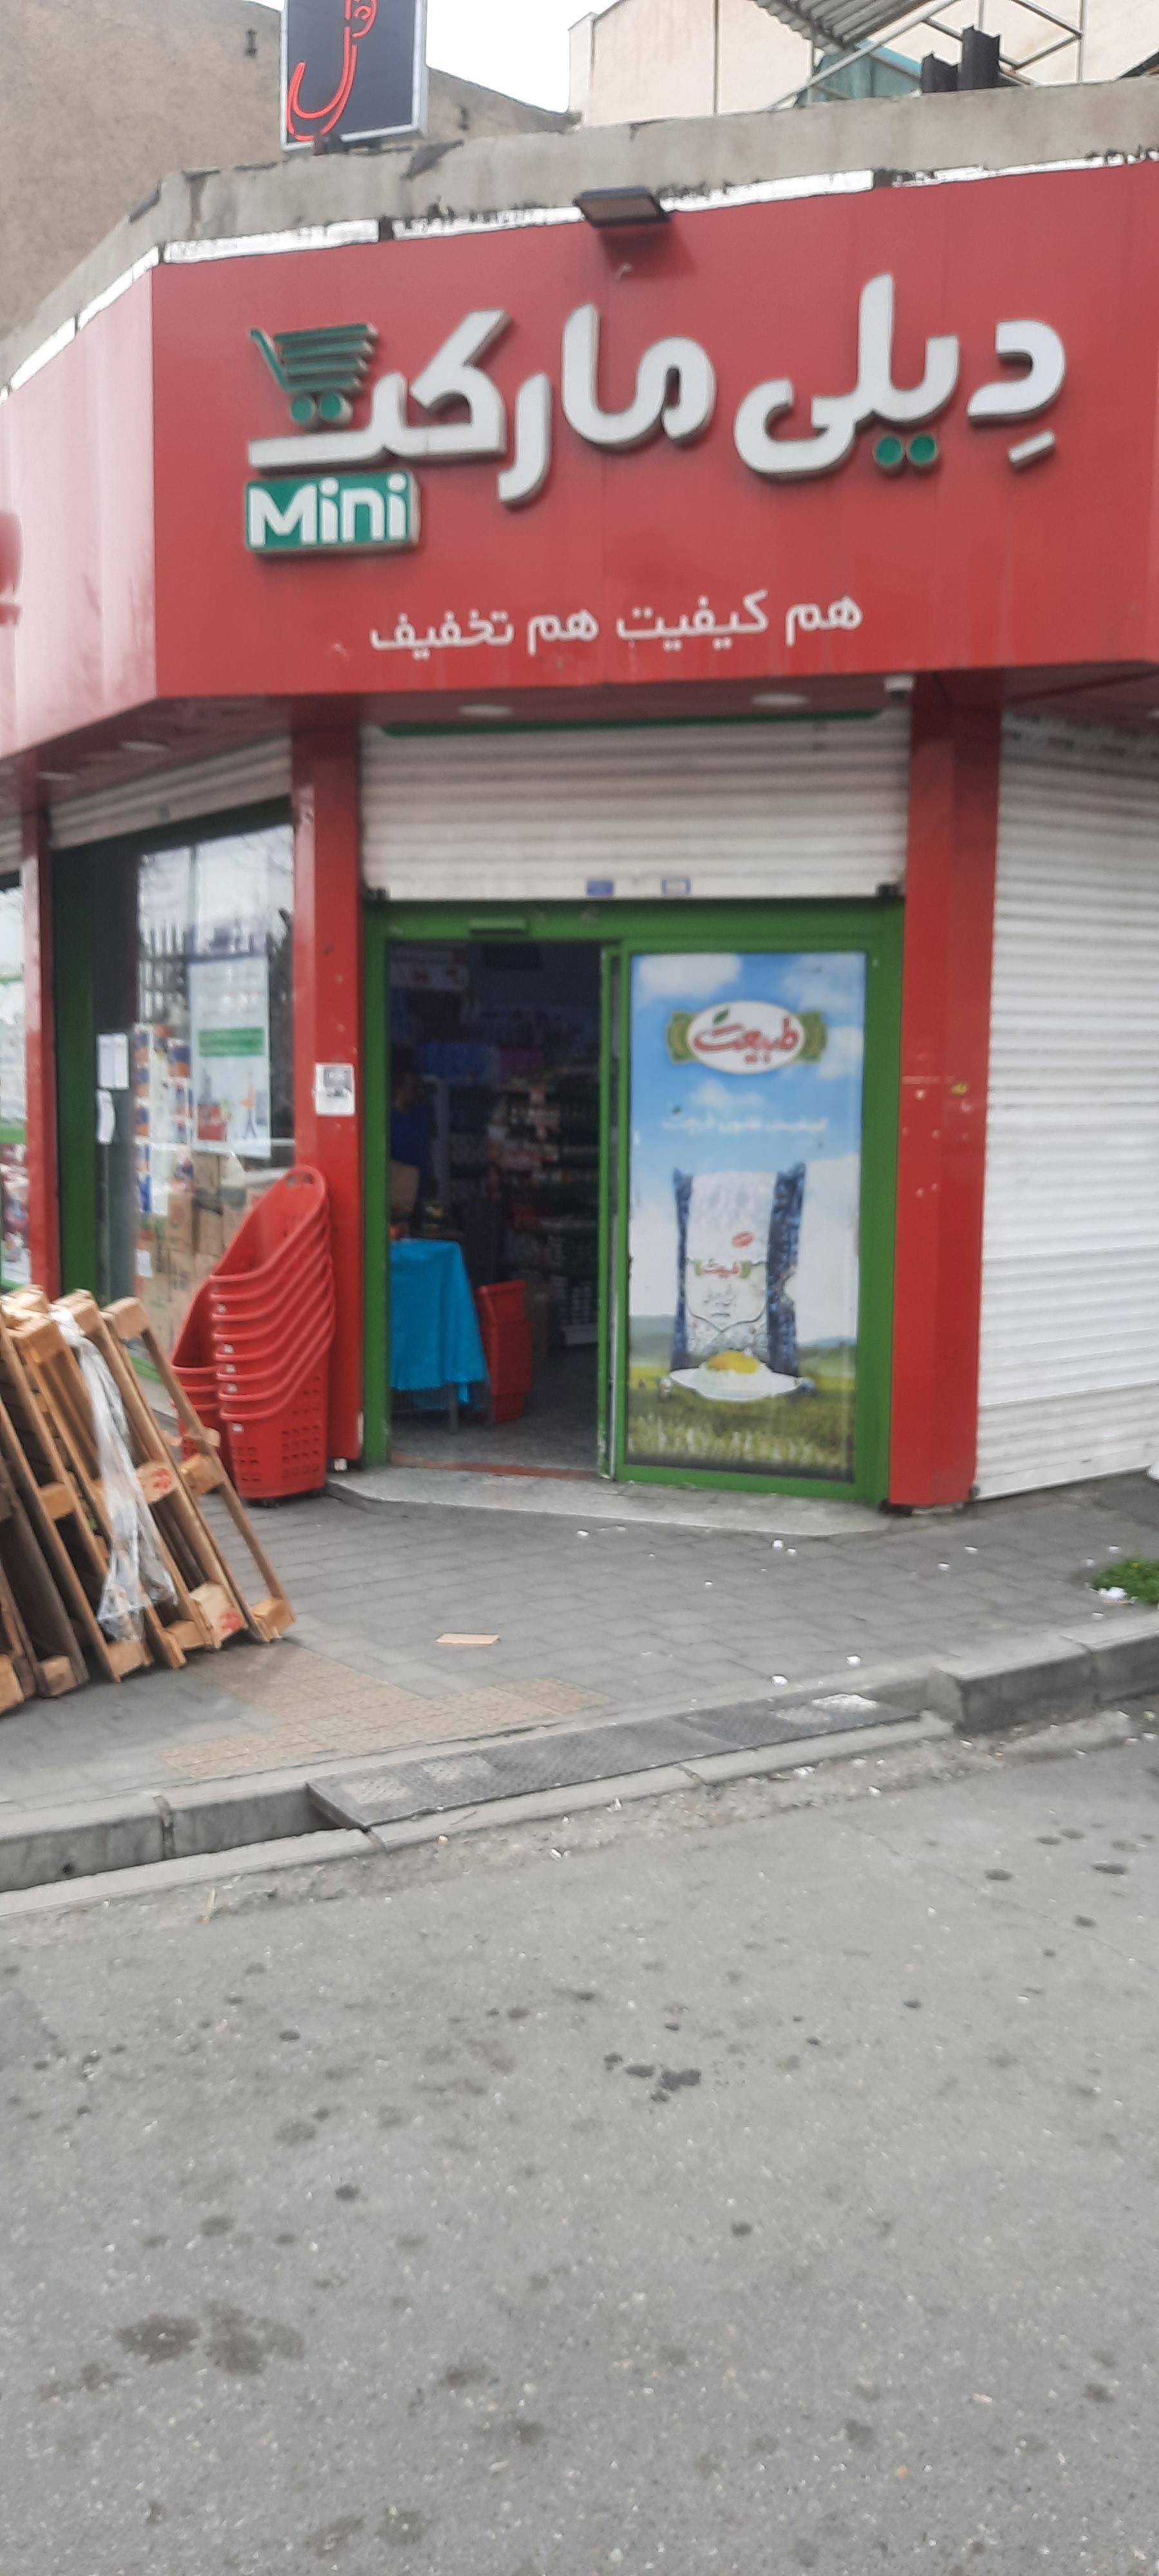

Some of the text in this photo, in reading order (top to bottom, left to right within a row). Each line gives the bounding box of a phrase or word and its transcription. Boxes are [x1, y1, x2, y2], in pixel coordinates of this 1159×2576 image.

[247, 301, 717, 505] مارکت
[247, 474, 408, 547] Mini
[370, 588, 863, 660] هم کیفیت هم تخفیف
